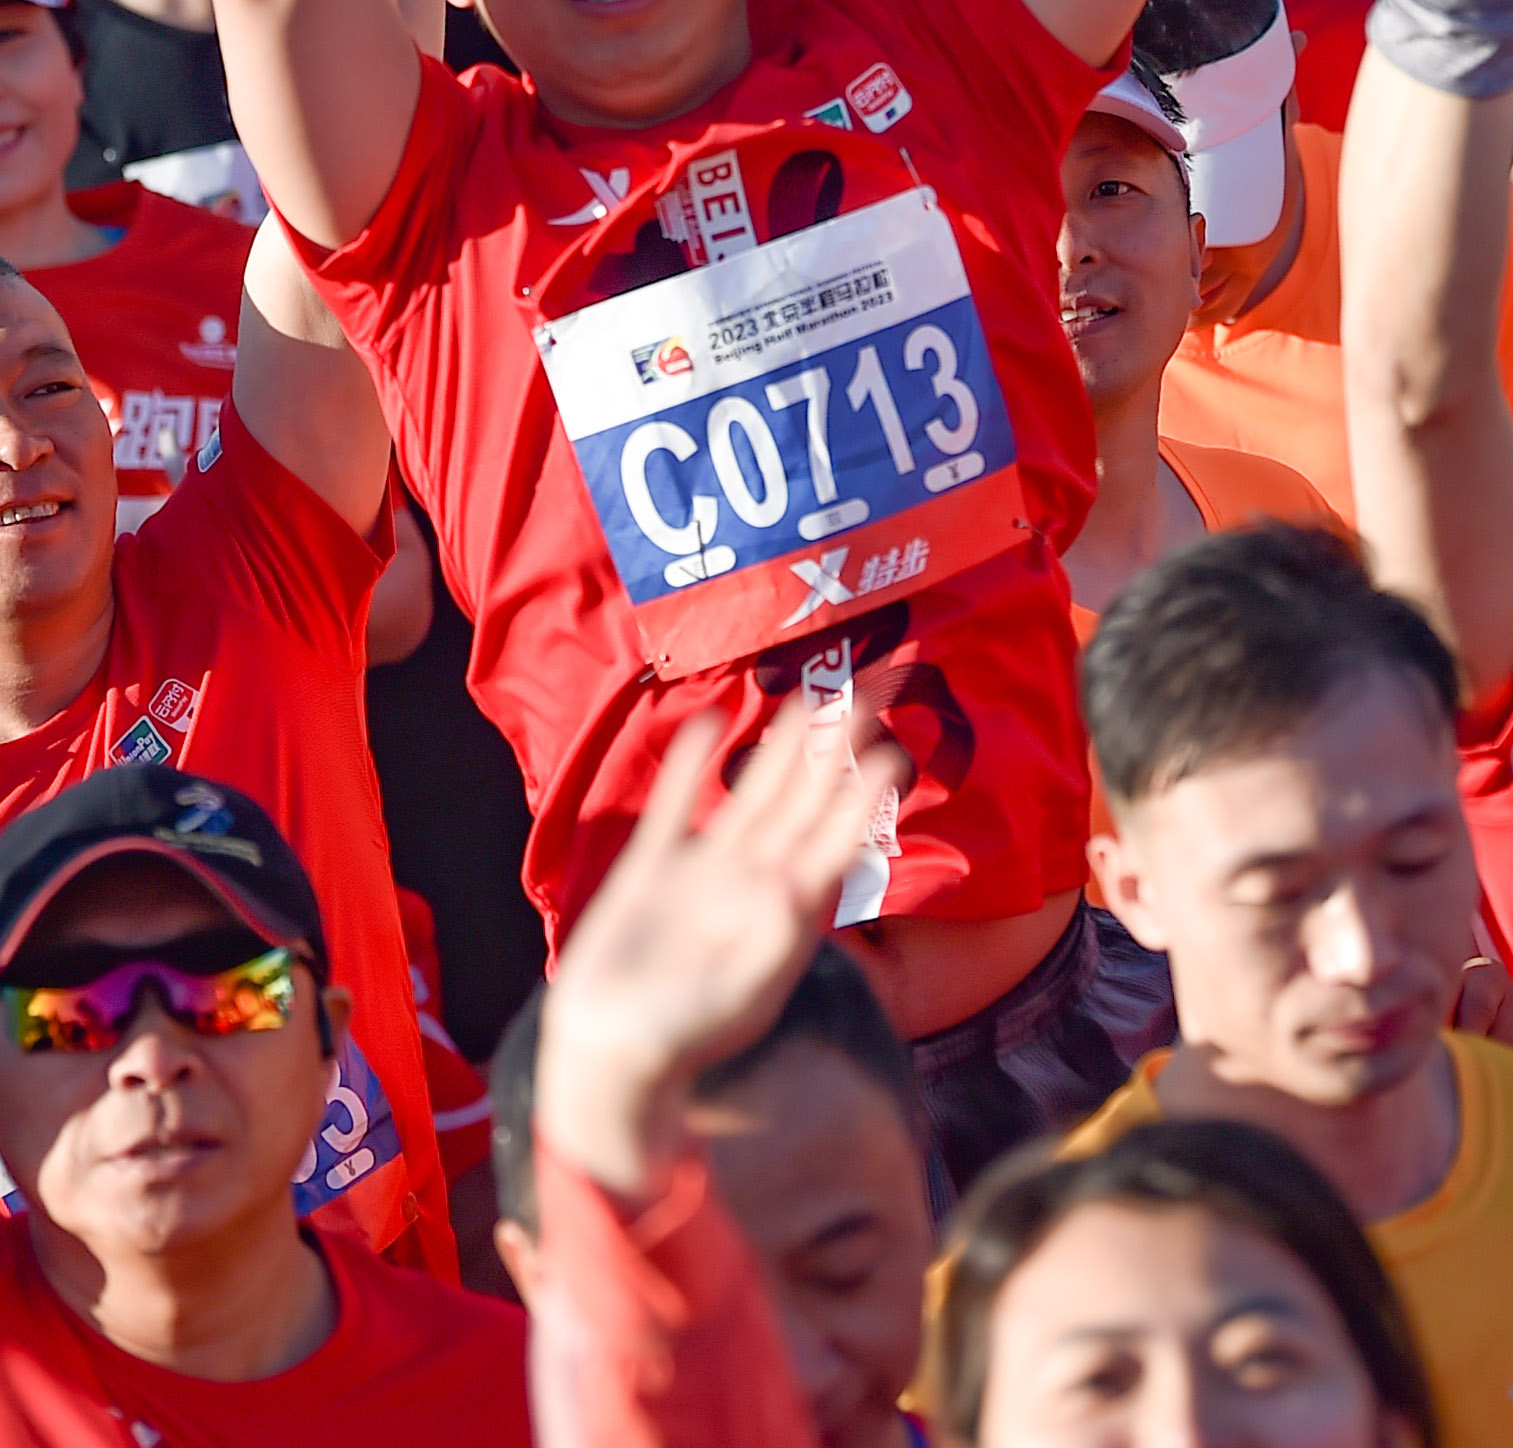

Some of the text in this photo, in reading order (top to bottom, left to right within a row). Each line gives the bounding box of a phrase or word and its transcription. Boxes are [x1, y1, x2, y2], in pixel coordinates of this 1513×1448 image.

[697, 162, 746, 261] BEI
[708, 318, 759, 352] 2023
[620, 325, 979, 556] C0713
